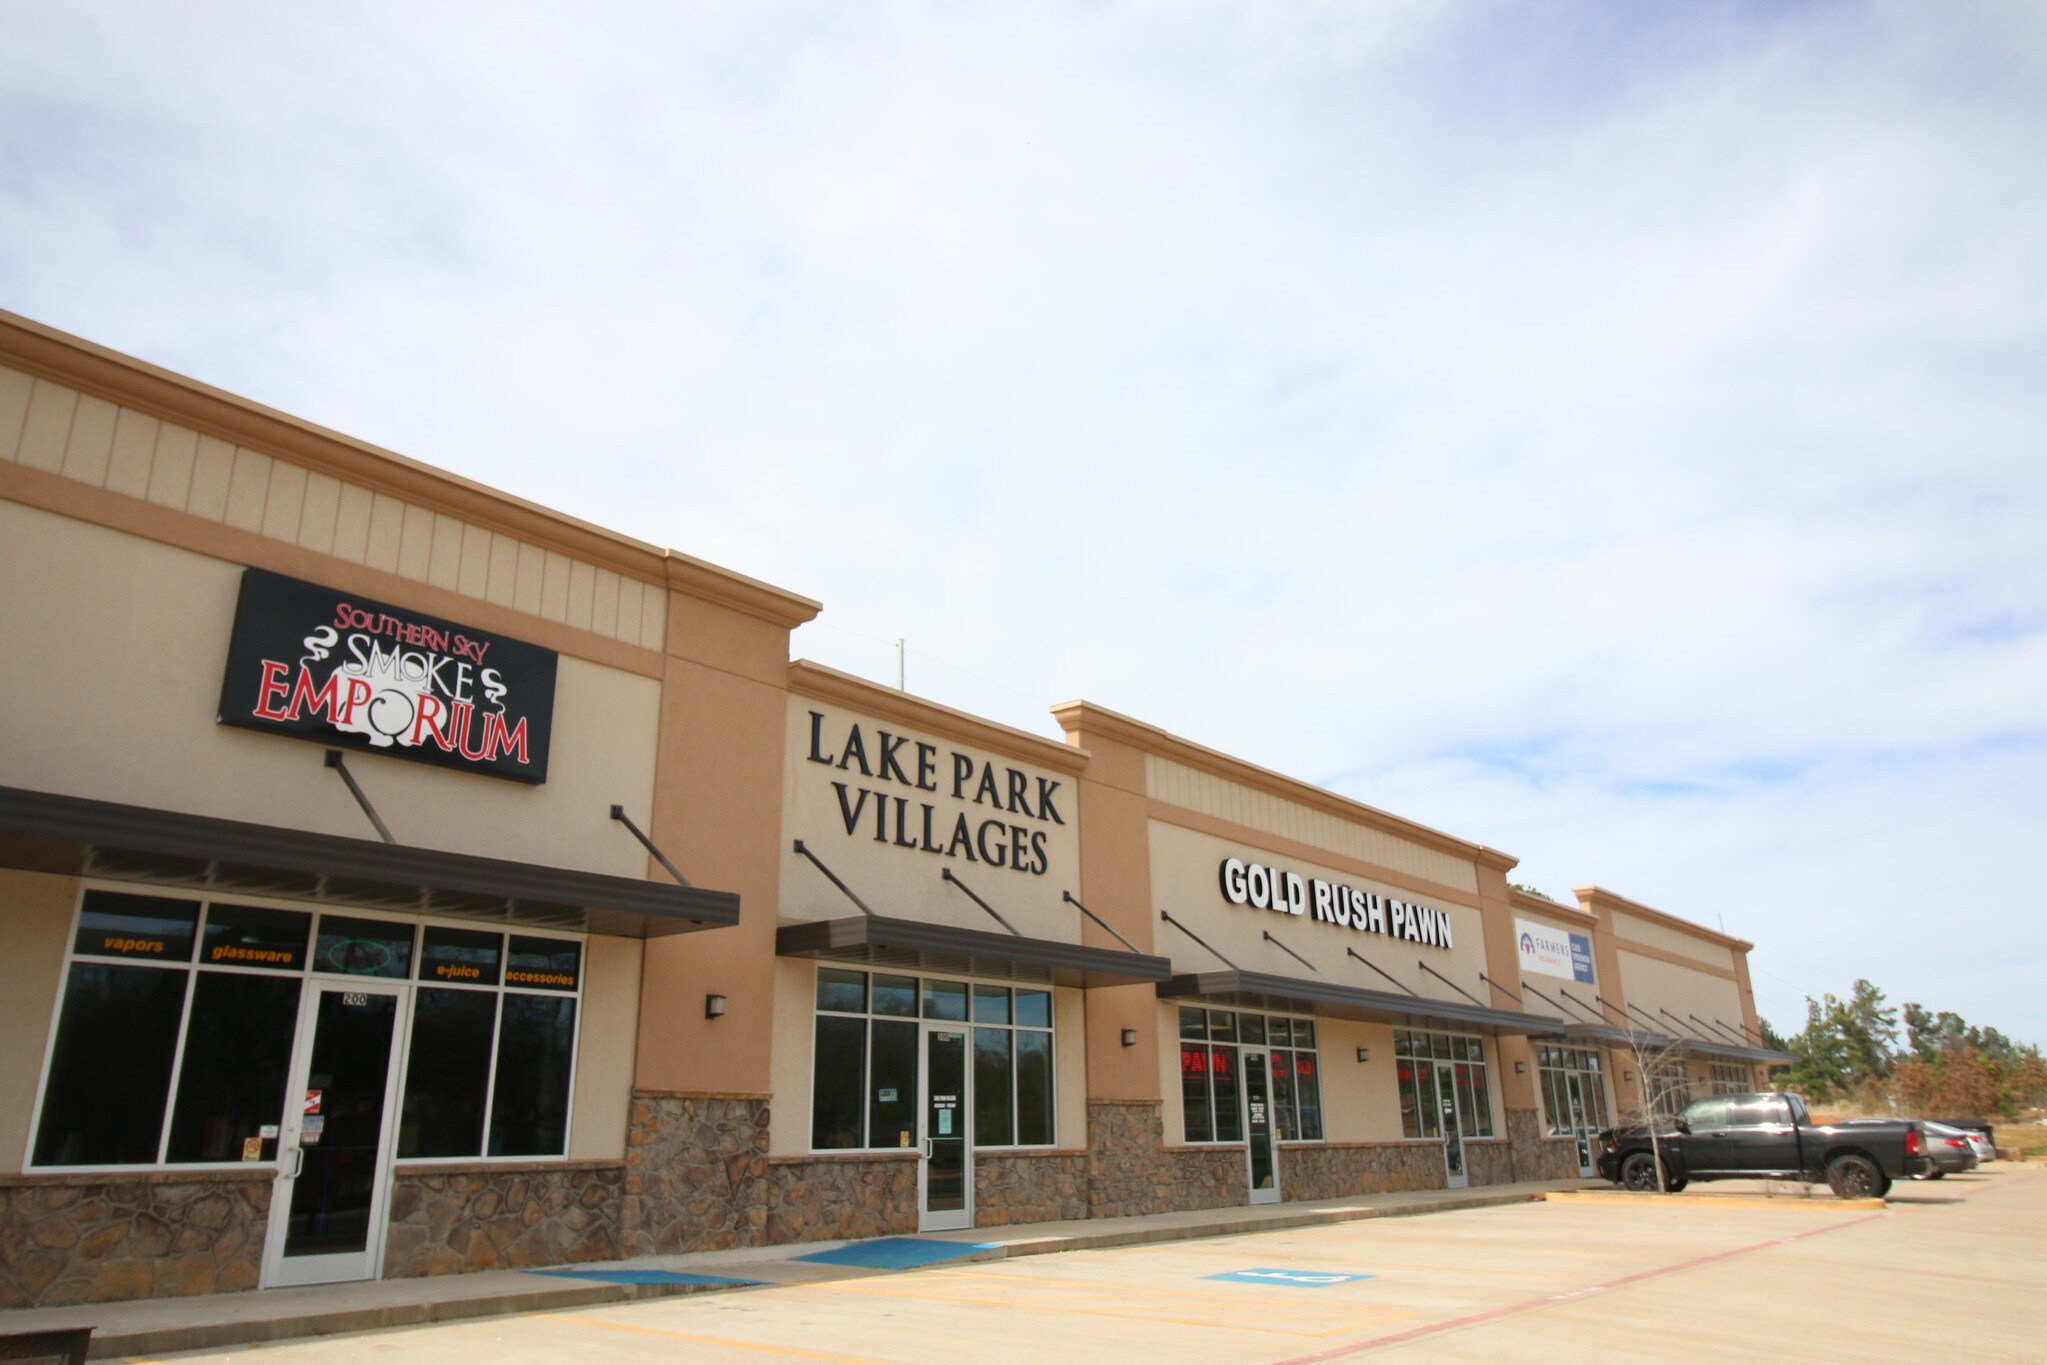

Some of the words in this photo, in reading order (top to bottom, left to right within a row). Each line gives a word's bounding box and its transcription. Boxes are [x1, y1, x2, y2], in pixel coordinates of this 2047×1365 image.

[334, 603, 448, 651] SOUTHERN
[452, 634, 490, 666] SKY
[342, 633, 474, 704] SMOKE
[252, 658, 531, 764] EMPORIUM
[807, 710, 937, 792] LAKE
[950, 752, 1066, 825] PARK
[831, 781, 1048, 875] VILLAGES
[1219, 857, 1306, 916] GOLD
[1308, 878, 1385, 934] RUSH
[1386, 899, 1454, 949] PAWN
[103, 936, 164, 953] vapors
[211, 945, 293, 963] glassware
[1536, 937, 1570, 957] FARMERS
[436, 964, 481, 979] e-juice
[505, 970, 575, 987] accessories
[343, 993, 367, 1006] 200
